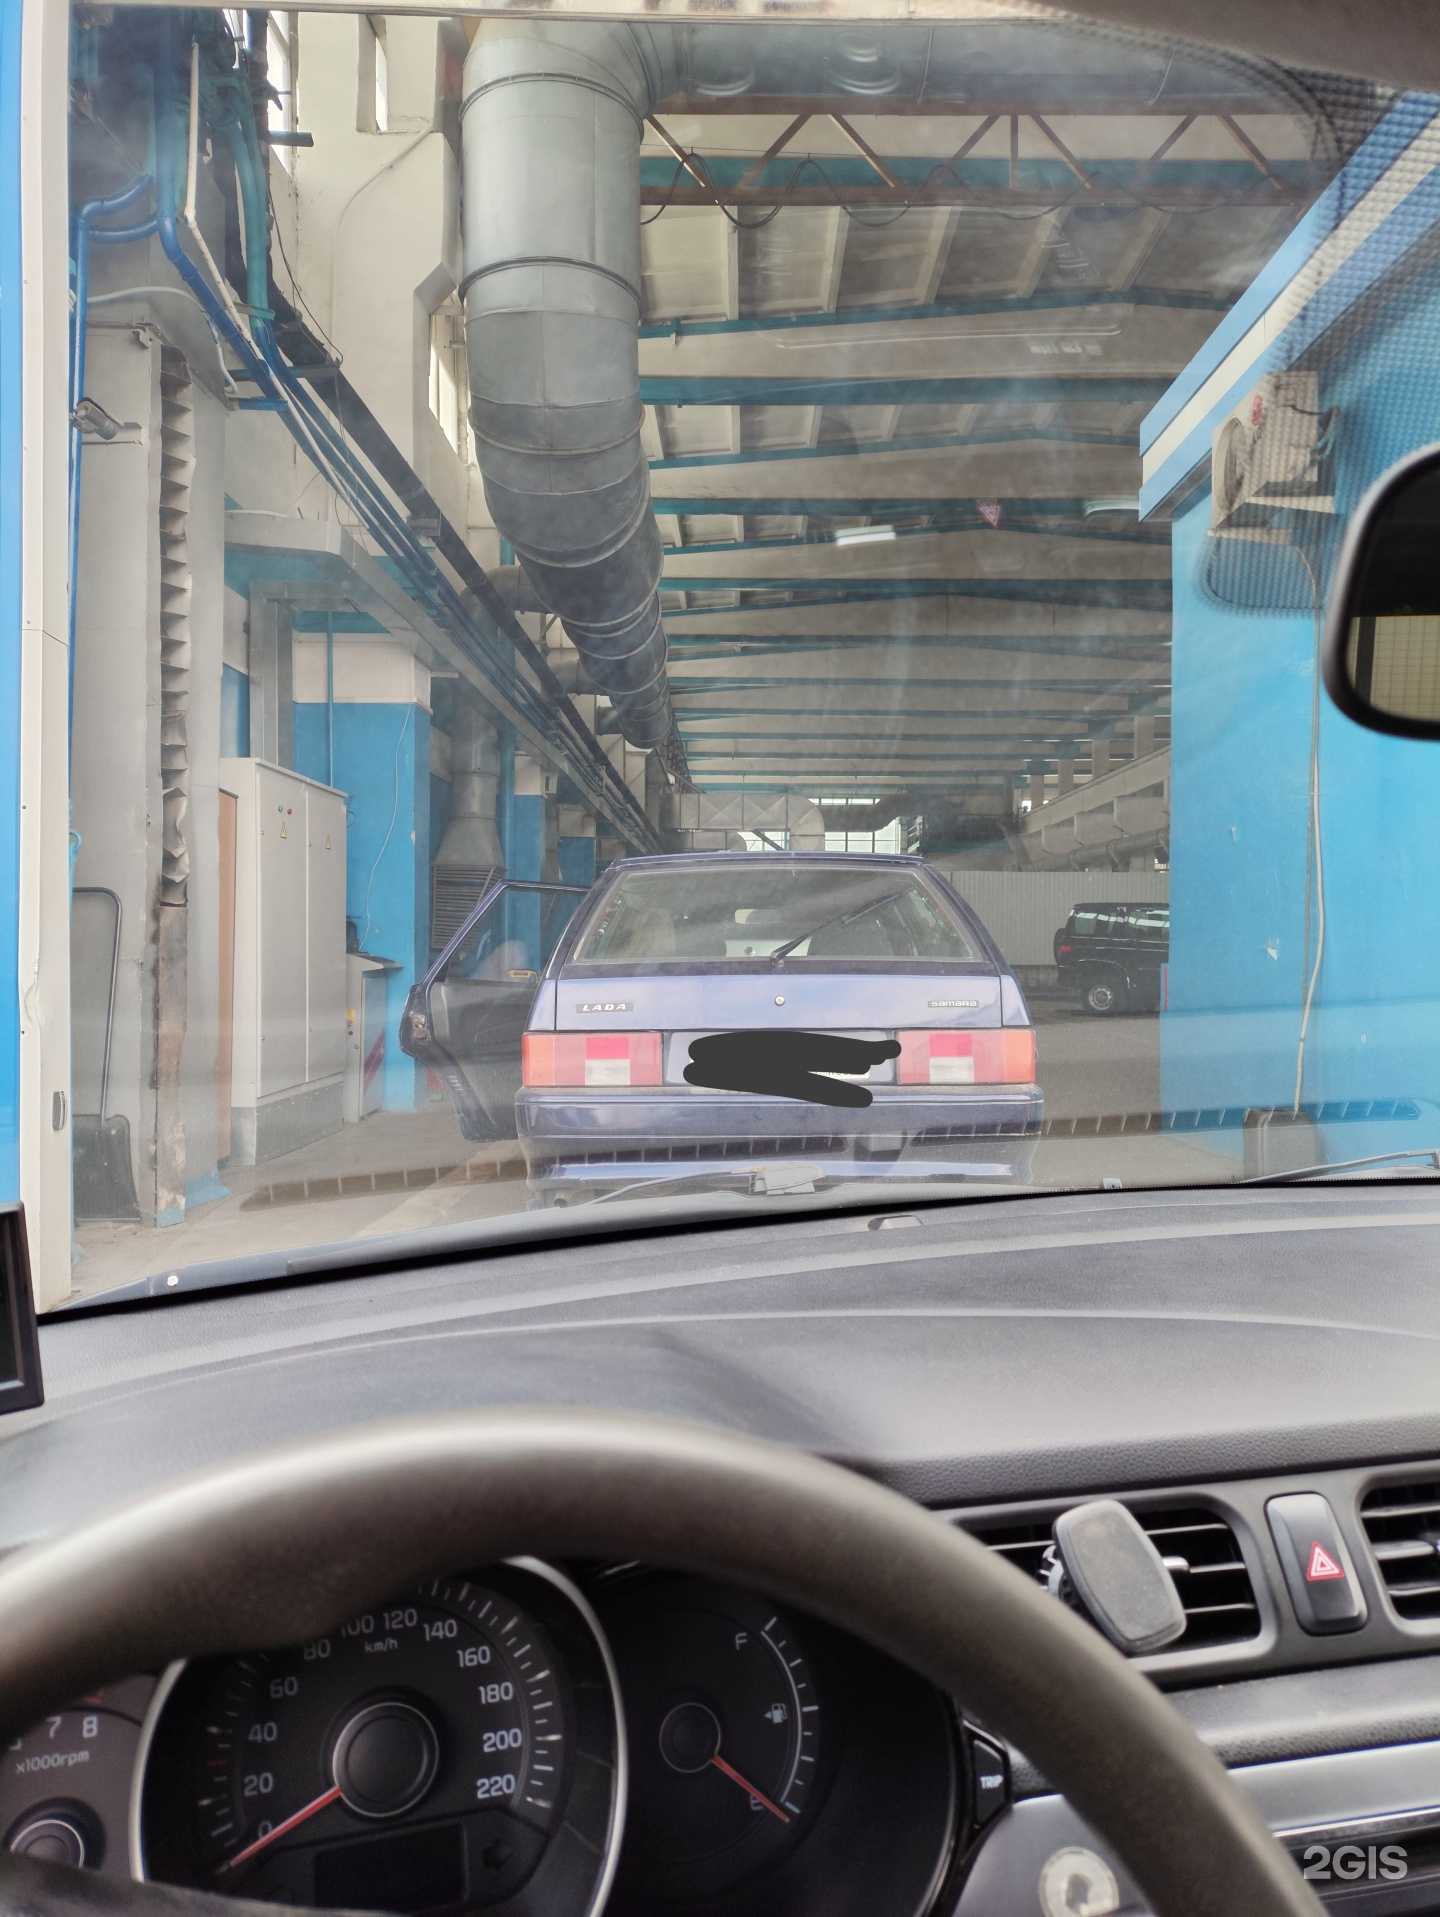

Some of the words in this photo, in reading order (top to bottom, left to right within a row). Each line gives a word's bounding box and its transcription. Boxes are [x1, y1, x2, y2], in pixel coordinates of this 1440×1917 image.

[582, 1003, 627, 1012] LADA
[383, 1608, 418, 1631] 120
[423, 1618, 458, 1641] 140
[303, 1639, 331, 1660] 80
[364, 1637, 399, 1654] km/h
[735, 1632, 748, 1650] F
[457, 1645, 491, 1668] 160
[269, 1676, 299, 1699] 60
[477, 1681, 513, 1704] 180
[45, 1715, 62, 1739] 7
[82, 1716, 99, 1739] 8
[247, 1721, 278, 1743] 40
[482, 1727, 522, 1753] 200
[15, 1749, 91, 1775] x1000rpm
[243, 1771, 274, 1797] 20
[476, 1773, 516, 1800] 220
